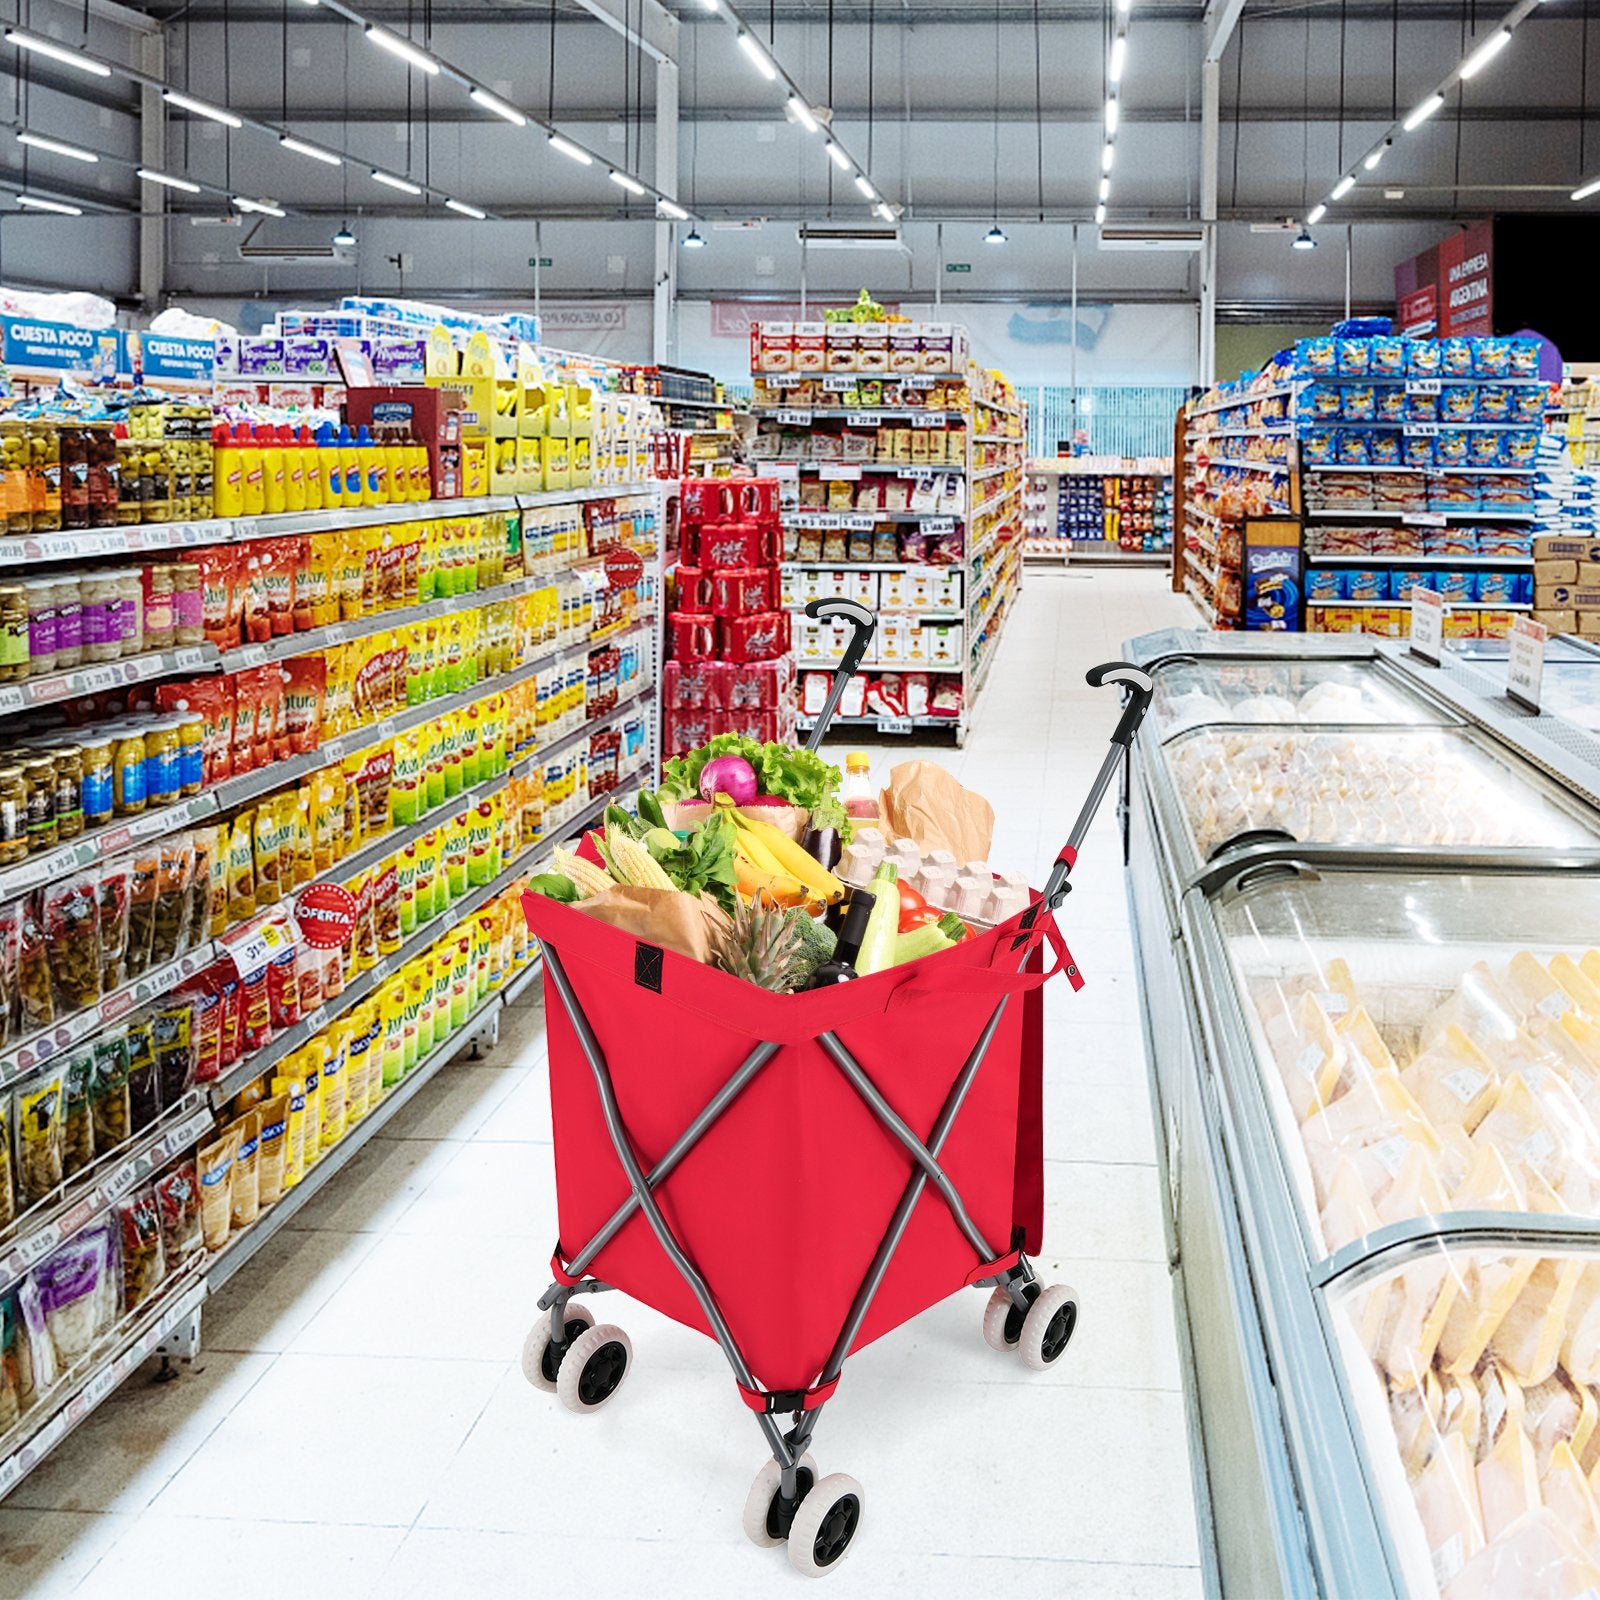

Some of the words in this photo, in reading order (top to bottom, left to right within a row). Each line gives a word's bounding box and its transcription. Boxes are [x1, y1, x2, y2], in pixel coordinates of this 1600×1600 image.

[1449, 278, 1489, 308] ARGENTINA
[11, 324, 58, 344] CUESTA
[59, 331, 93, 348] POCO
[148, 340, 186, 358] CUESTA
[186, 343, 214, 360] POCO
[300, 906, 350, 925] OFERTA
